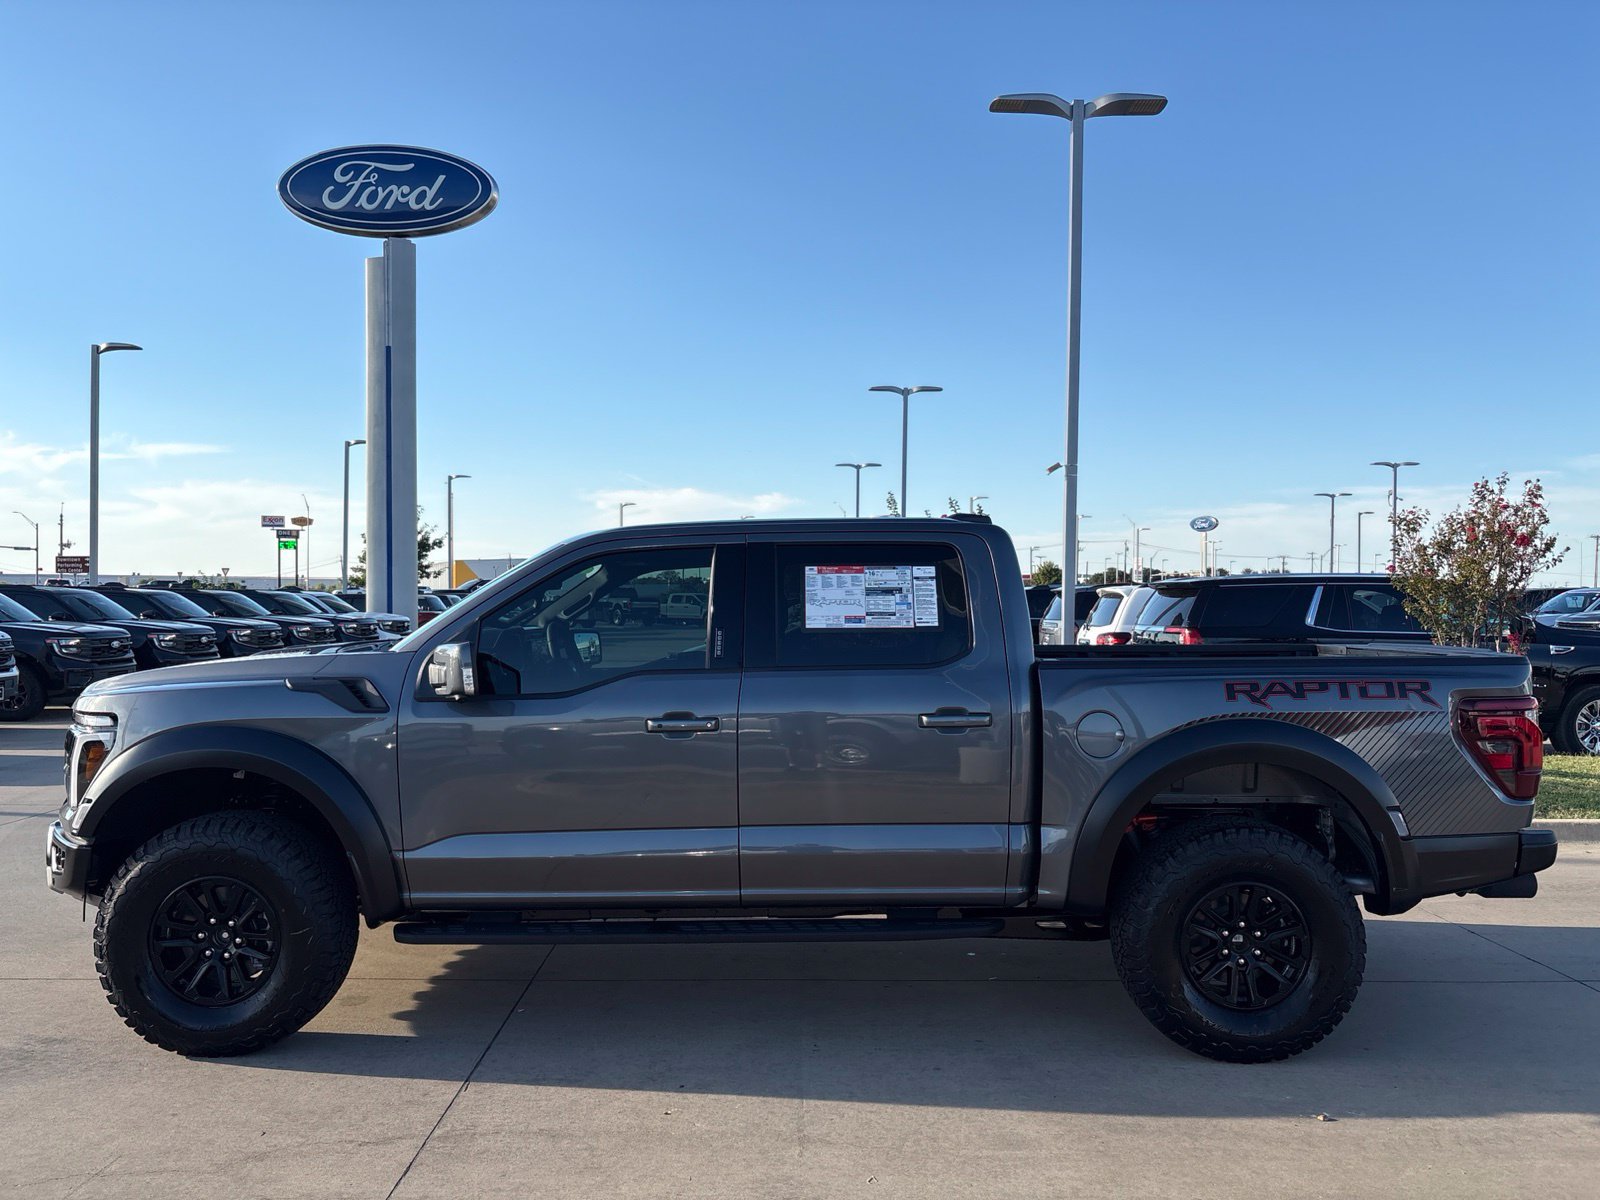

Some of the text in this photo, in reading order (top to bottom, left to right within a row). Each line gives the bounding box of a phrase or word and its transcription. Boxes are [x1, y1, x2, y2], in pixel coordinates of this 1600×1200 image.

[322, 160, 446, 210] Ford
[263, 516, 284, 524] Exxon
[1224, 680, 1442, 710] RAPTOR
